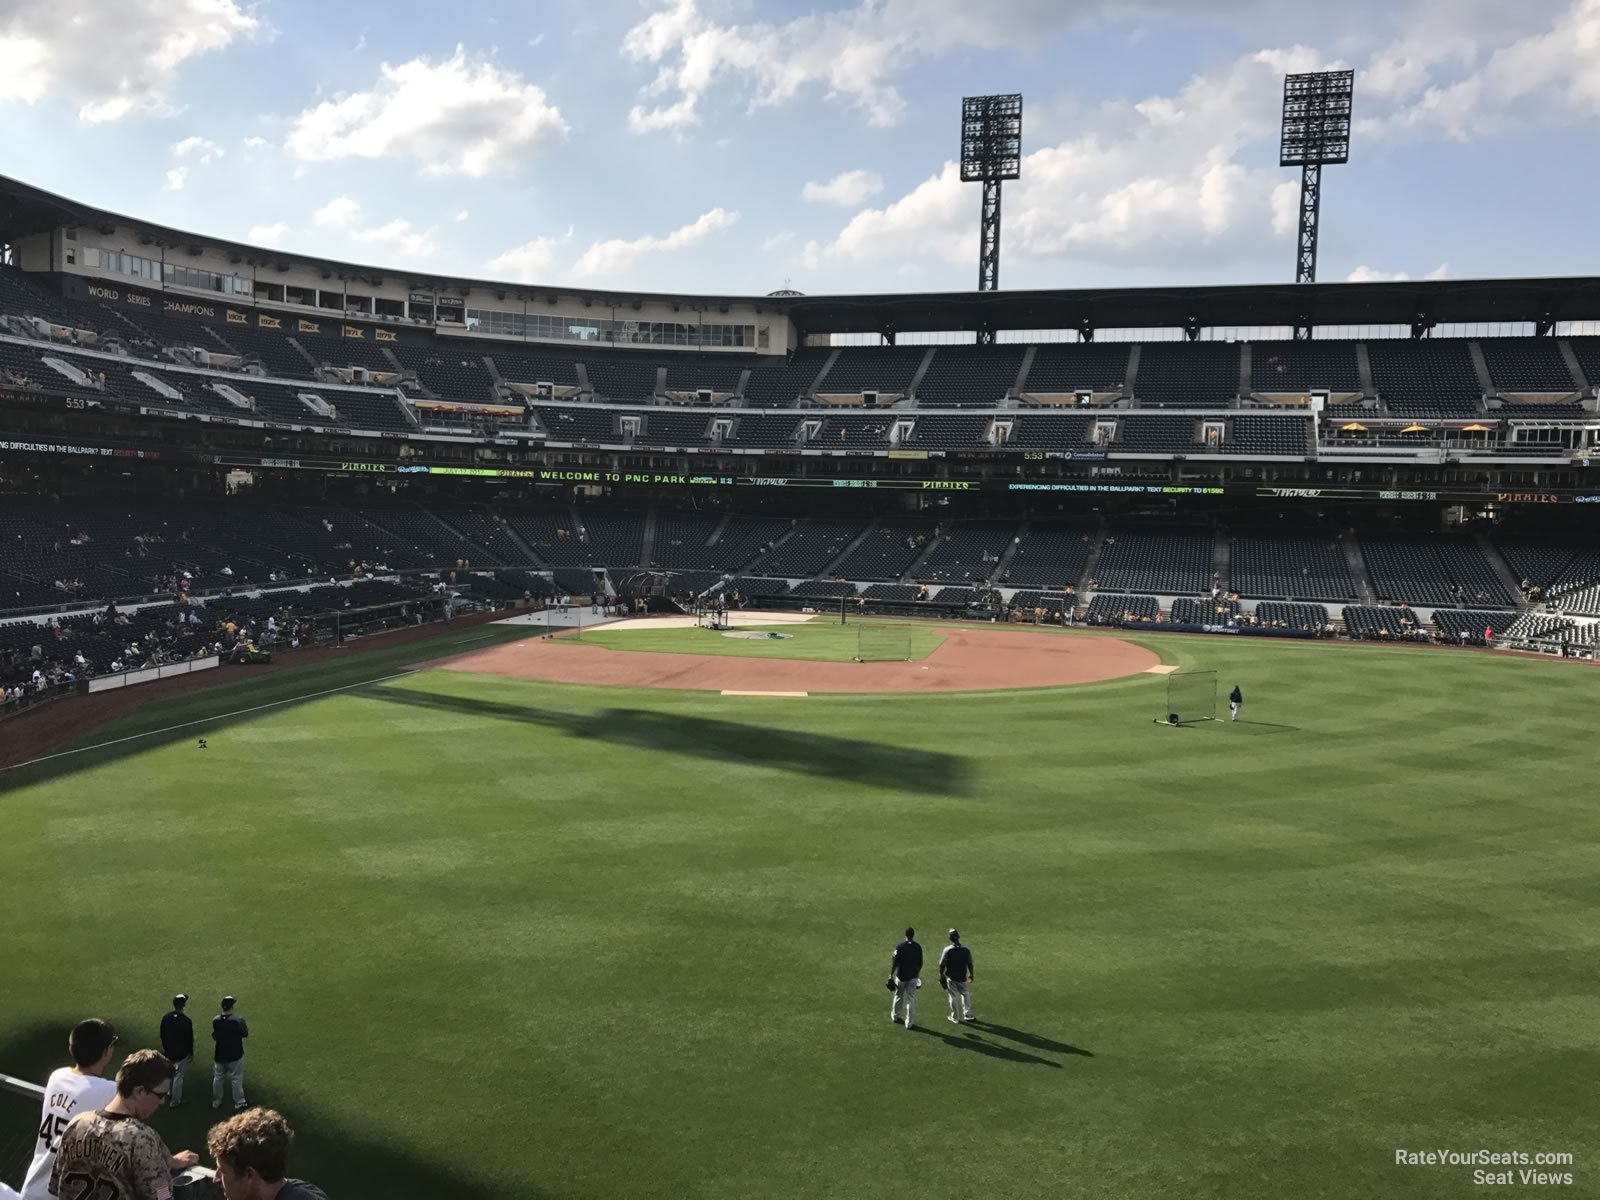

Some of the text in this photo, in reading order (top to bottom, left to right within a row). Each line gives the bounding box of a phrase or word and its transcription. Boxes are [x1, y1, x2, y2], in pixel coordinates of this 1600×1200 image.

[88, 285, 215, 318] WORLD SERIES CHAMPIONS
[65, 397, 85, 410] 5:53
[10, 442, 48, 452] DIFFICULTIES
[48, 444, 55, 452] IN
[56, 445, 67, 453] THE
[67, 445, 99, 455] BALLPARK?
[100, 448, 113, 456] TEXT
[137, 450, 145, 458] TO
[1024, 451, 1043, 460] 5:53
[540, 470, 600, 481] WELCOME
[605, 473, 620, 482] TO
[625, 473, 649, 483] PNC
[654, 474, 685, 484] PARK
[1008, 483, 1051, 491] EXPERIENCING
[1162, 486, 1192, 494] SECURITY
[50, 1093, 77, 1113] COLE
